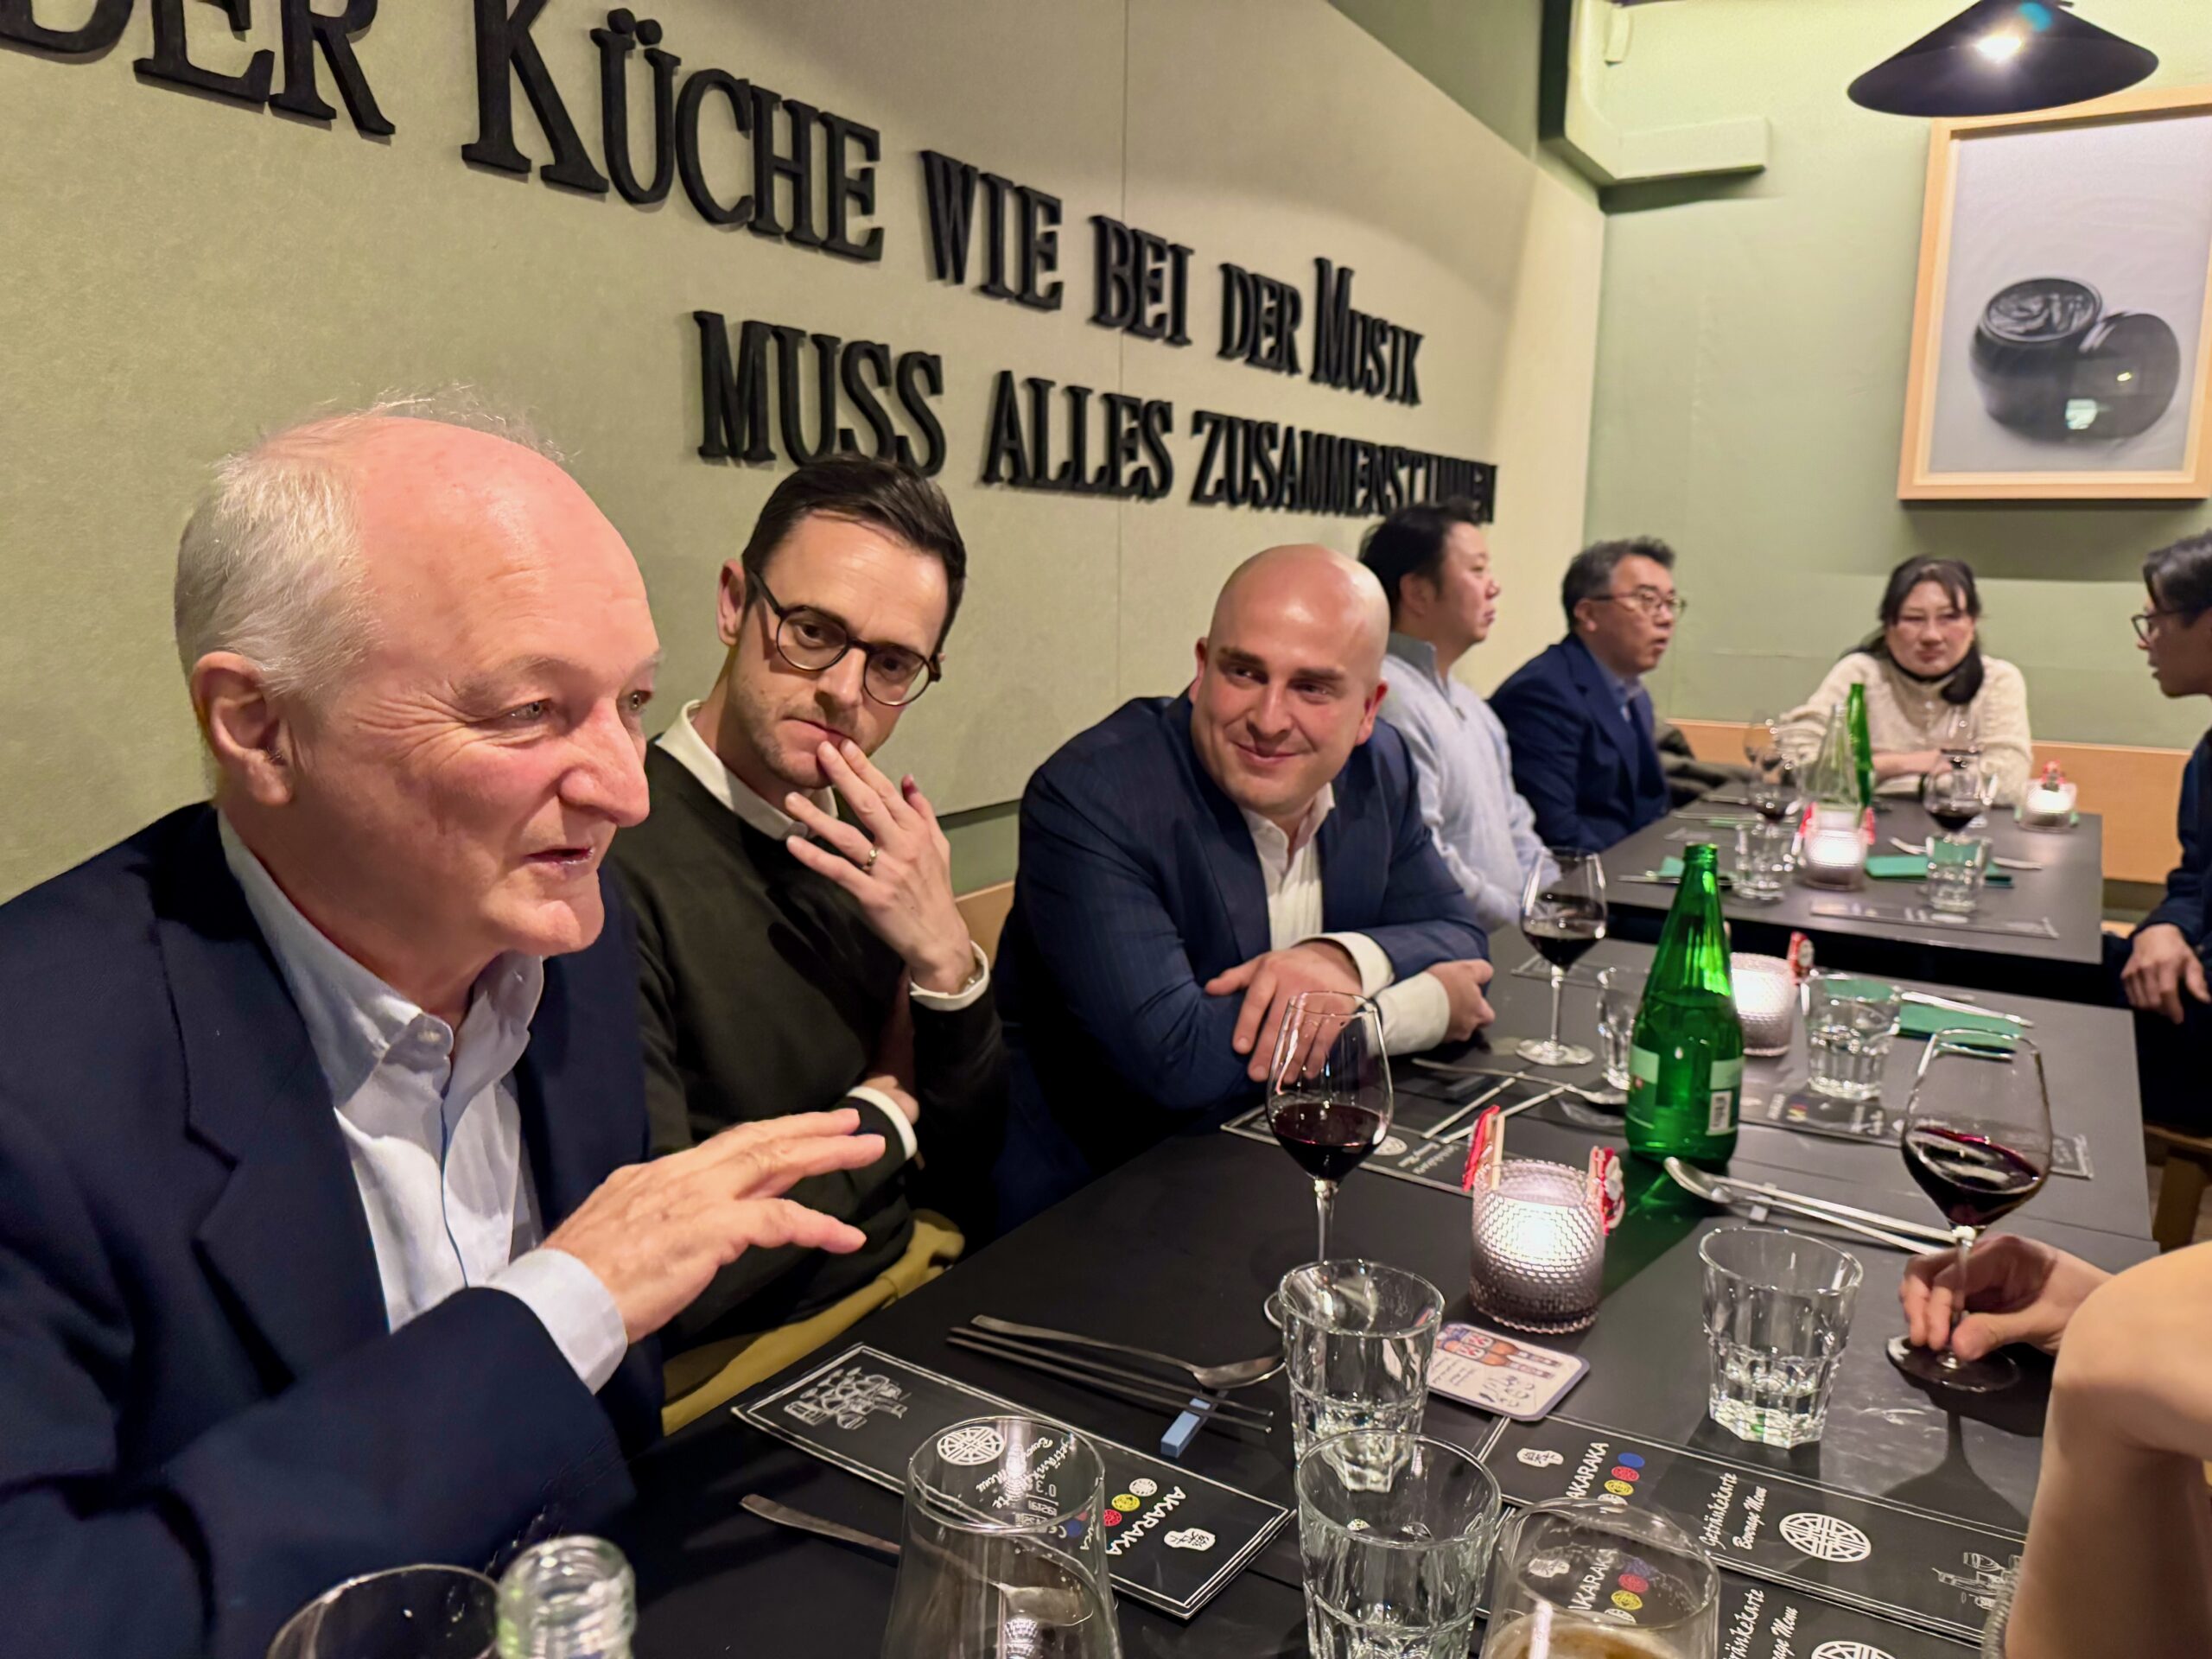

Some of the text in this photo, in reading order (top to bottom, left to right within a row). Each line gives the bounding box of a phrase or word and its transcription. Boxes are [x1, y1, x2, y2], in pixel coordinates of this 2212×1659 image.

[921, 149, 1064, 310] WIE
[1090, 215, 1194, 346] BEI
[1217, 263, 1302, 375] DER
[693, 310, 946, 478] MUSS
[982, 370, 1173, 501] ALLES
[1566, 1442, 1610, 1499] AKARAKA
[1106, 1485, 1186, 1555] AKARAKA
[1699, 1471, 1738, 1550] Getränkekarte
[1732, 1485, 1769, 1550] Beverage Menu
[1771, 1605, 1799, 1638] Menu
